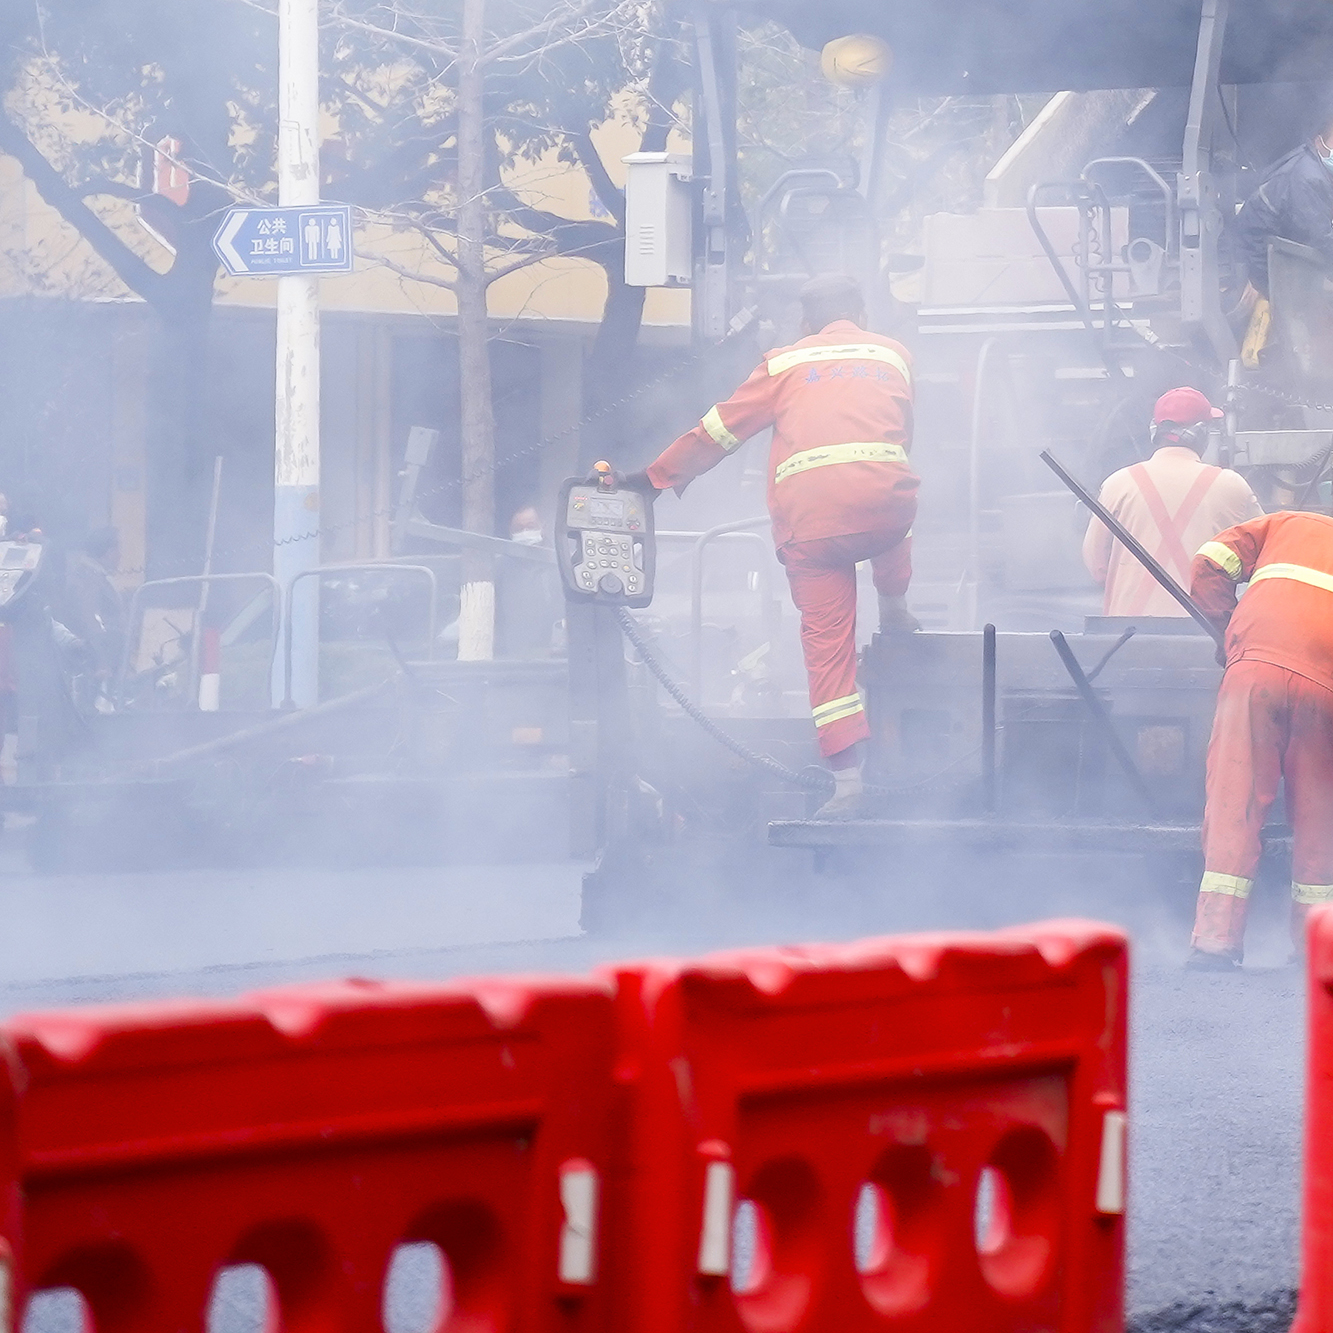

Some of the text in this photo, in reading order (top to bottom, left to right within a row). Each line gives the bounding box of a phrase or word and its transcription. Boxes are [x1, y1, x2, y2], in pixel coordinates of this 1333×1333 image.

[257, 218, 287, 235] 公共
[250, 237, 294, 255] 卫生间
